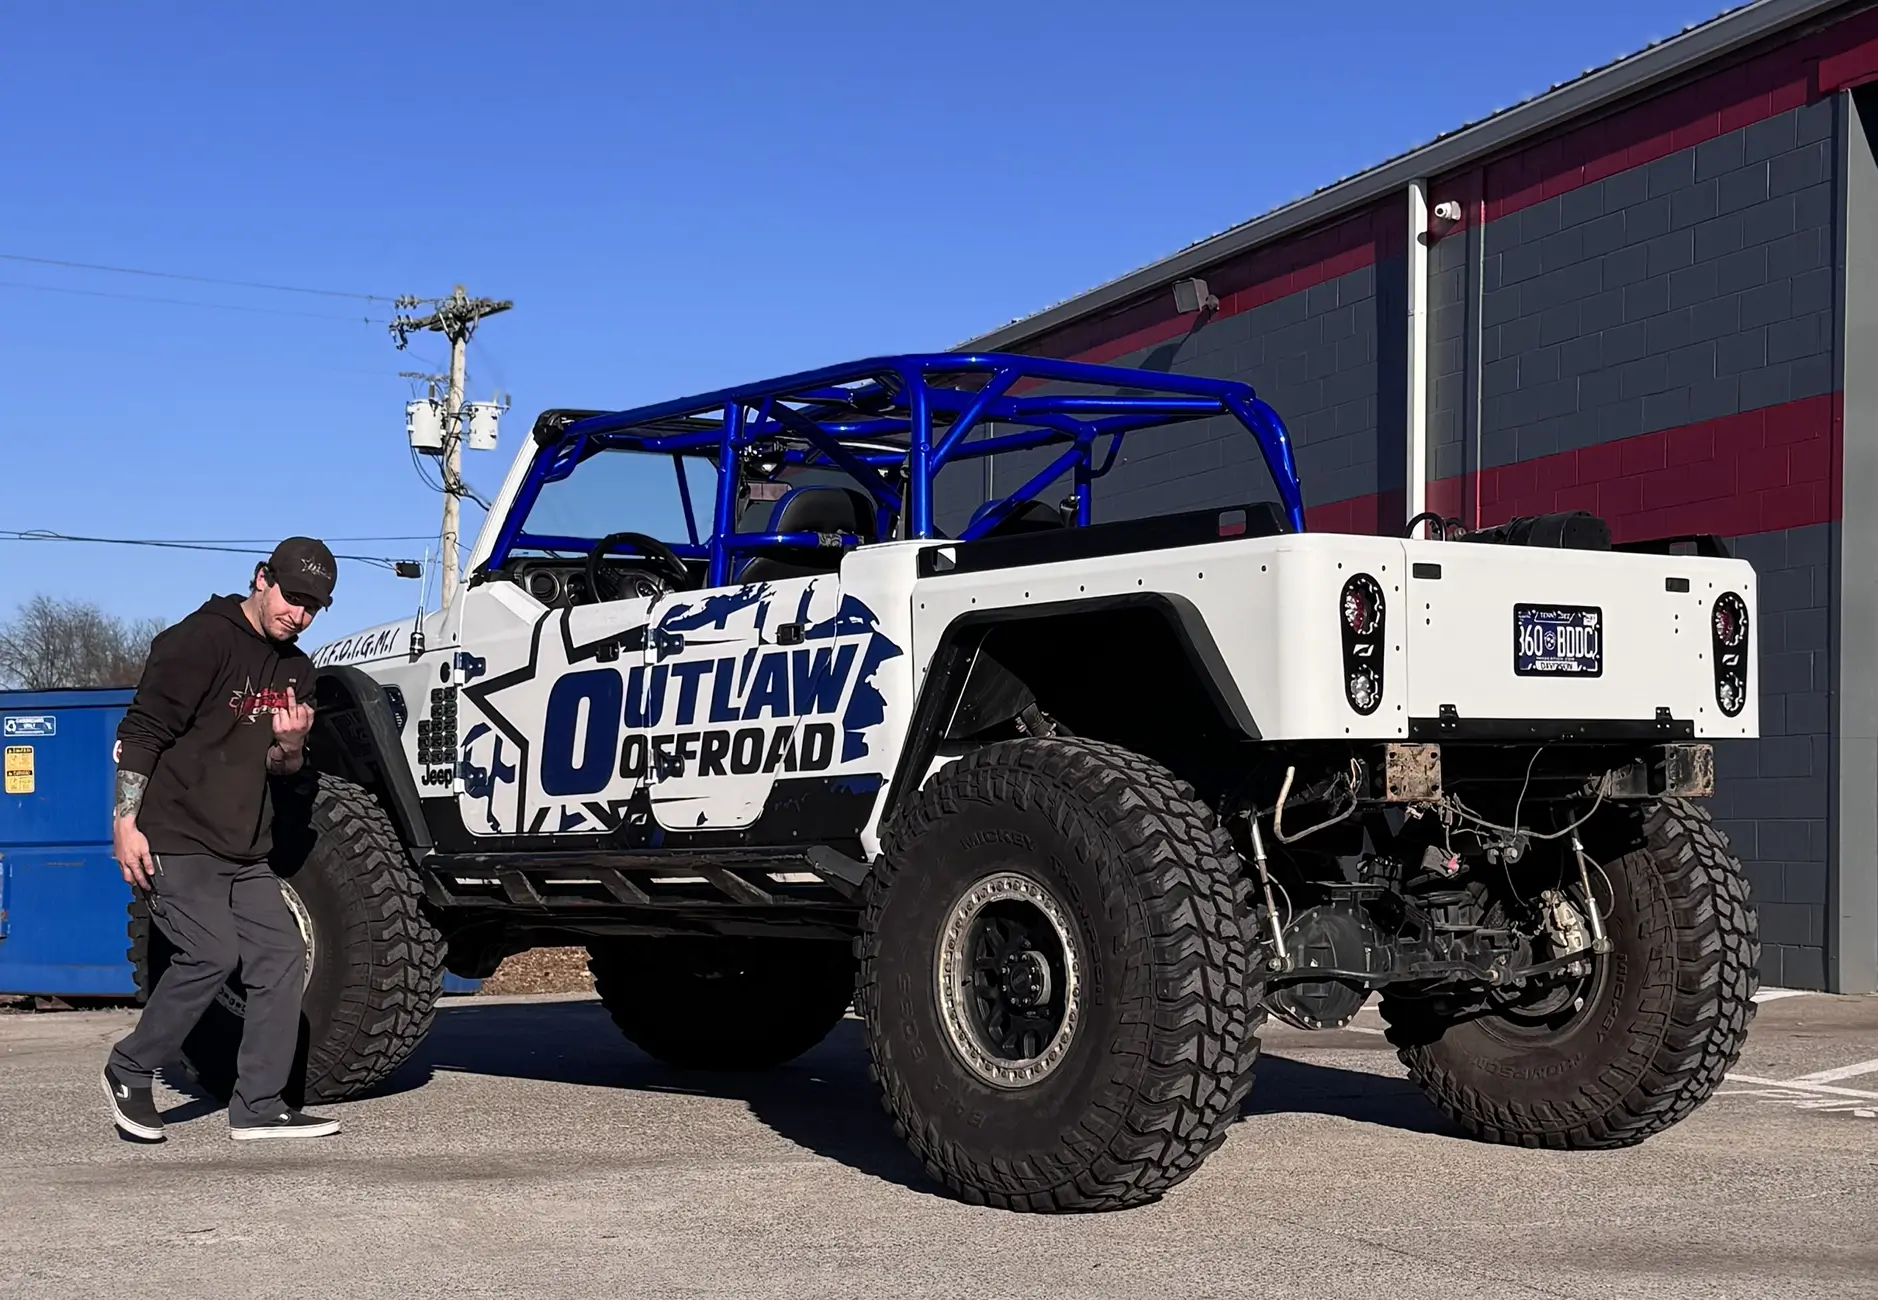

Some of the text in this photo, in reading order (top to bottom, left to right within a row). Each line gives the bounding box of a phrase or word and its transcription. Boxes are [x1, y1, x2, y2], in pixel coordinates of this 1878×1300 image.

[540, 643, 861, 796] OUTLAW
[619, 722, 836, 779] OFFROAD
[421, 763, 453, 788] Jeep
[959, 828, 1037, 852] MICKEY
